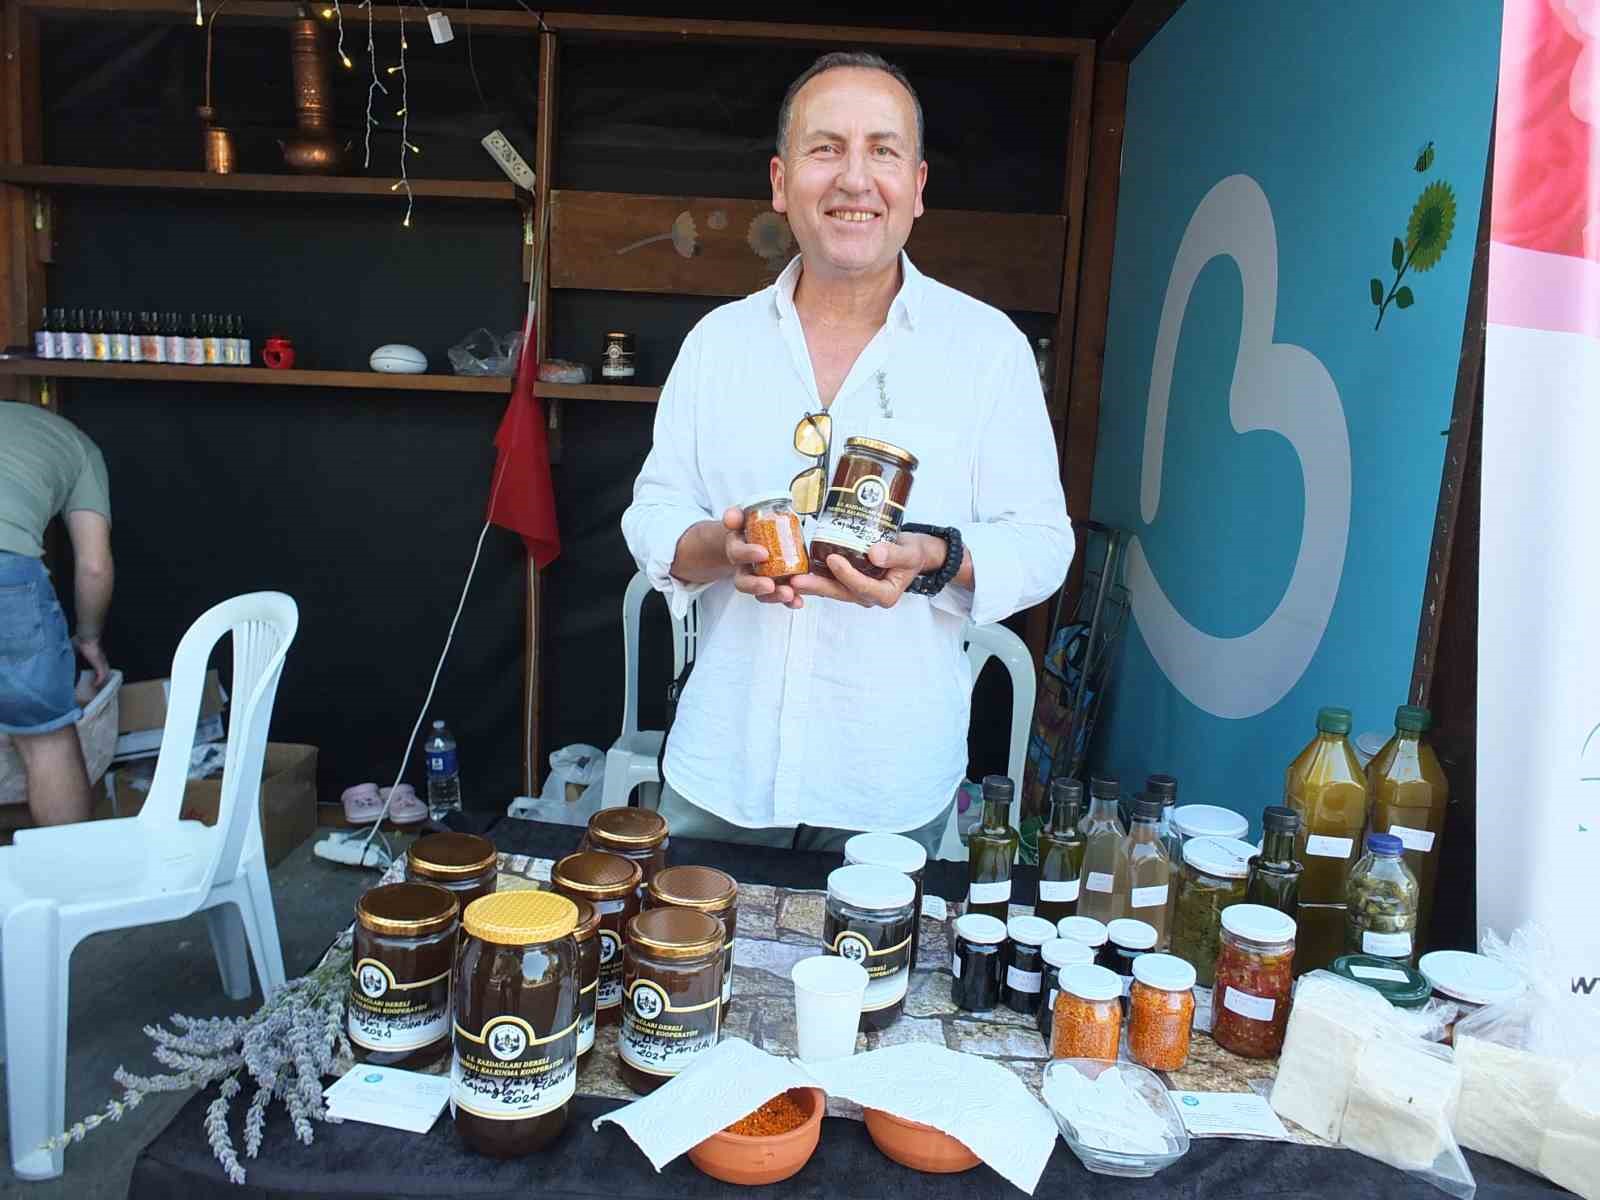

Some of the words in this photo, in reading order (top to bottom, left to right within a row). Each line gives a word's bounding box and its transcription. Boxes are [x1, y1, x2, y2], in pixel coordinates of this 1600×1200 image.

[1571, 976, 1600, 995] w
[476, 1057, 523, 1069] KAZDAĞLARI
[480, 1065, 520, 1077] KALKINMA
[501, 1092, 541, 1105] 2024
